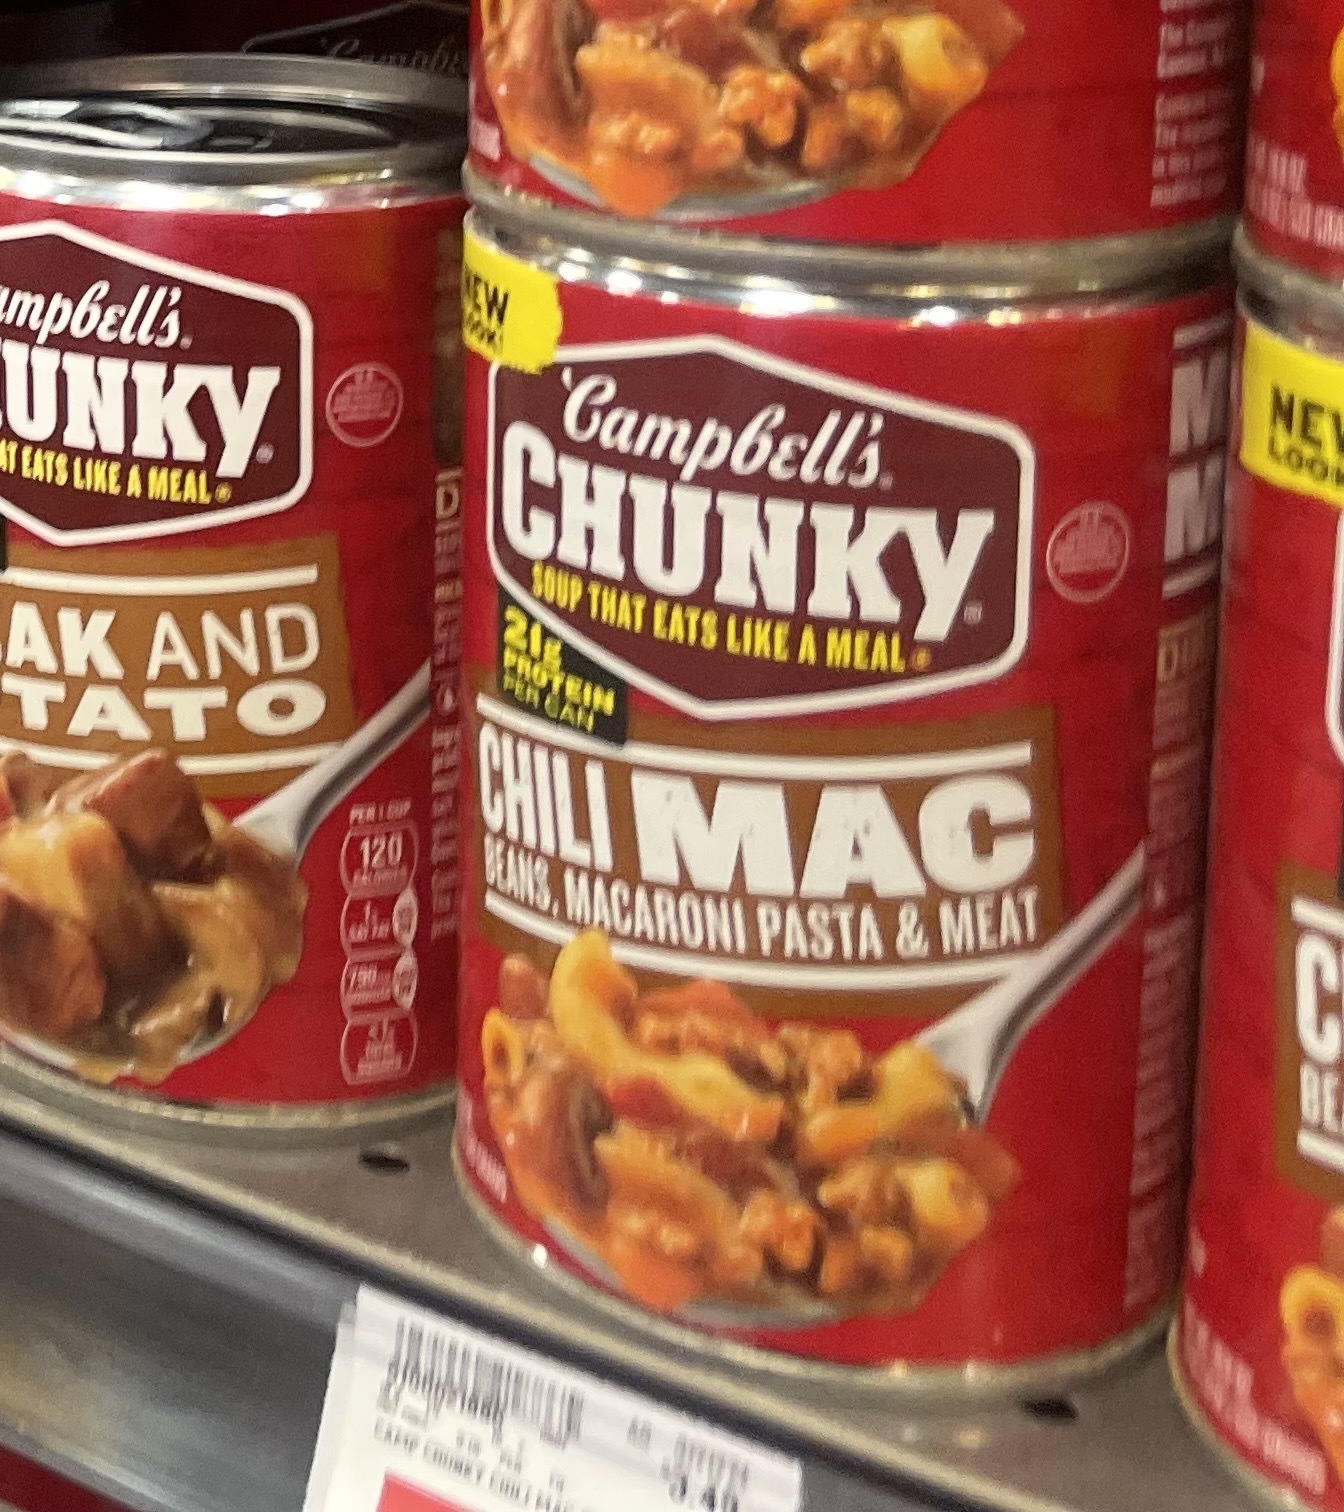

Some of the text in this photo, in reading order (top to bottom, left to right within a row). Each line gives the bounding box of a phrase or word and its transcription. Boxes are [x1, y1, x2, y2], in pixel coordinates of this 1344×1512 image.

[20, 445, 69, 487] EATS
[72, 455, 122, 496] LIKE
[125, 464, 141, 498] A
[146, 465, 212, 505] MEAL
[562, 365, 887, 490] Campbell's
[500, 419, 996, 644] CHUNKY
[146, 600, 321, 681] AND
[530, 559, 907, 675] SOUP THAT EATS LIKE A MEAL
[500, 649, 617, 716] PROTEIN
[360, 831, 403, 875] 120
[476, 720, 1038, 900] CHILI MAC
[483, 833, 559, 922] BEANS,
[564, 870, 749, 954] MACARONI
[756, 897, 884, 965] PASTA
[894, 896, 931, 958] &
[938, 885, 1041, 955] MEAT
